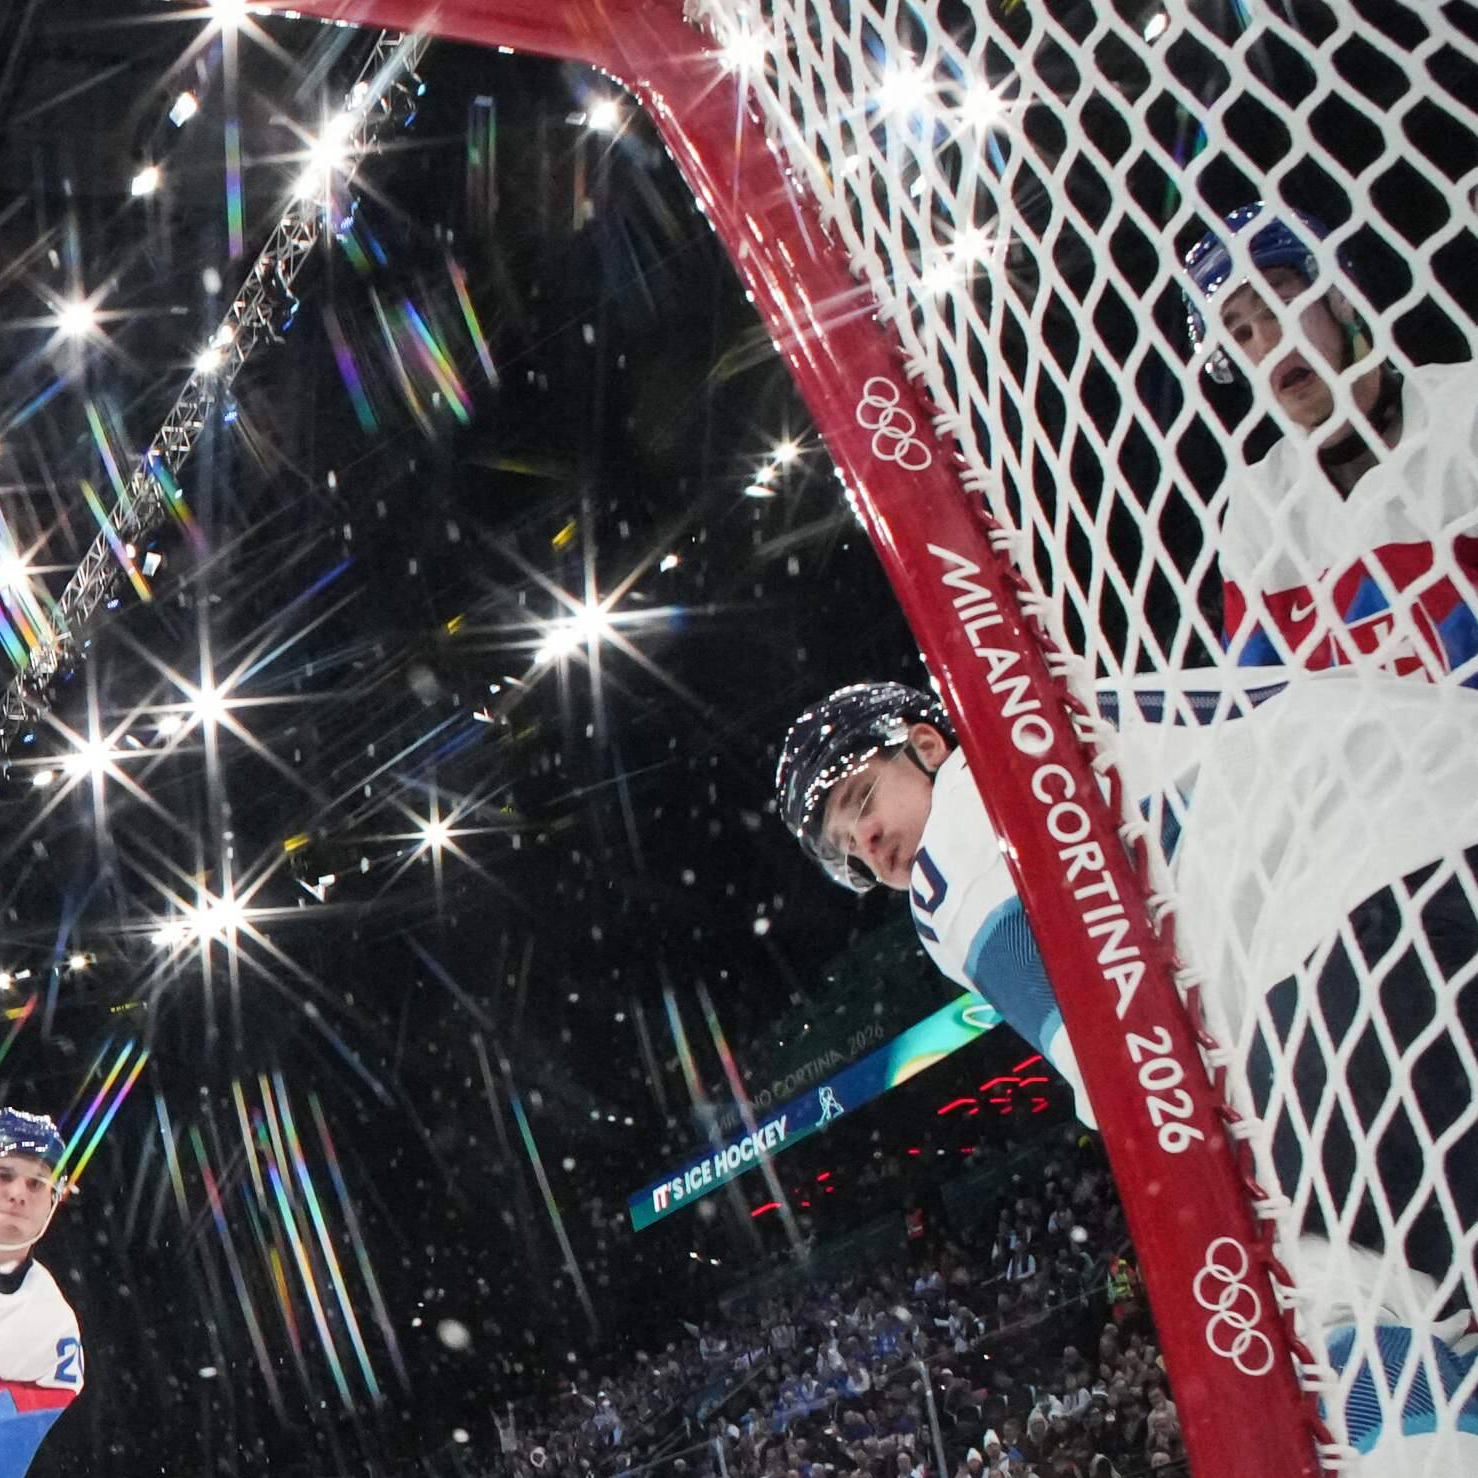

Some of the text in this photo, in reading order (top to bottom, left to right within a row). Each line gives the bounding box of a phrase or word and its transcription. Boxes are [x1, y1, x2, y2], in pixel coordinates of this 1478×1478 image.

[925, 542, 1205, 1155] MILANO CORTINA 2026
[652, 1115, 787, 1213] IT'S ICE HOCKEY
